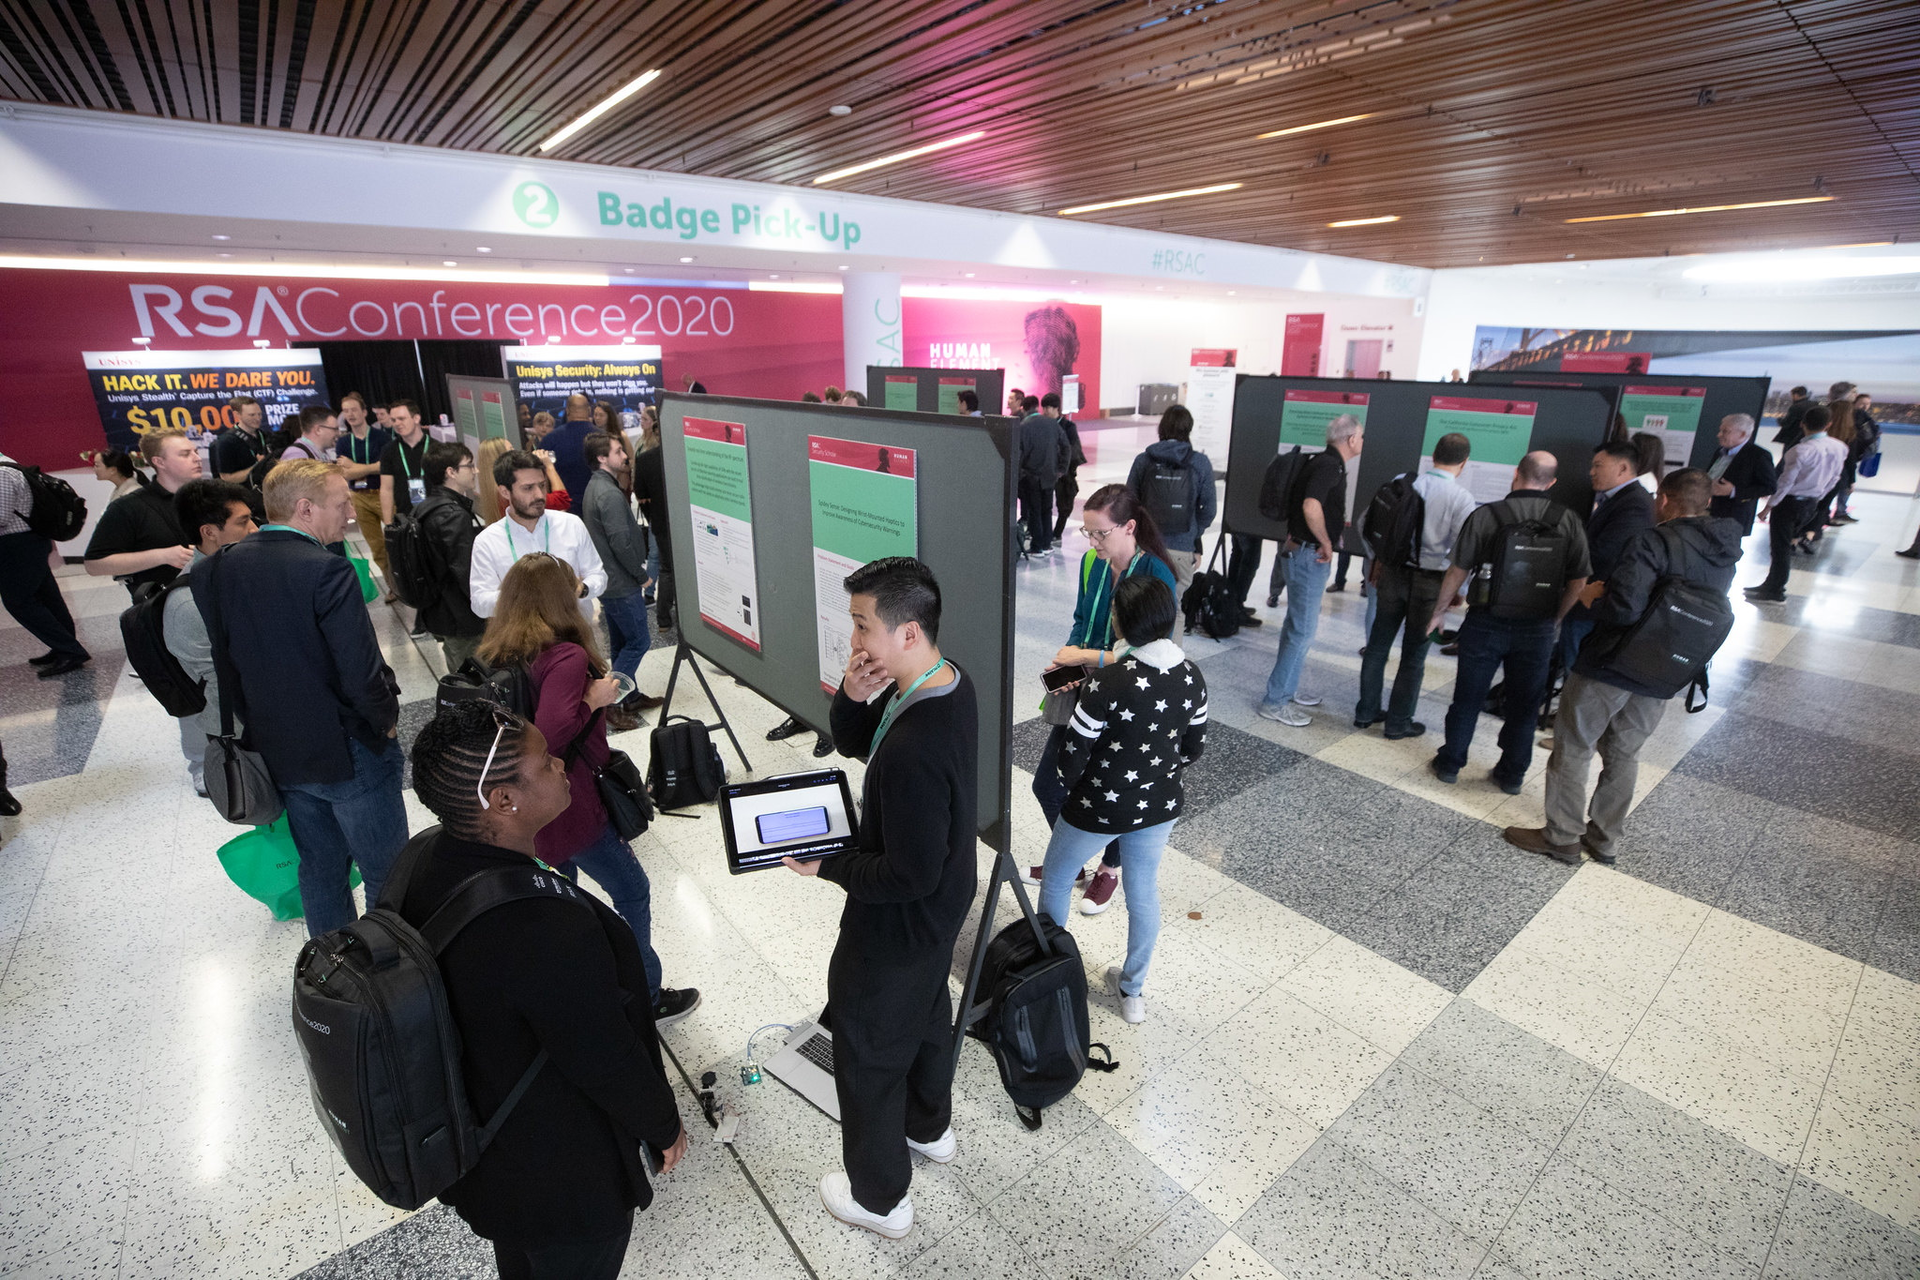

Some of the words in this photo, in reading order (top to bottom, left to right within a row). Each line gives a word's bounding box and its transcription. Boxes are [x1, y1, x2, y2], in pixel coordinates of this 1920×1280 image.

[522, 183, 551, 225] 2
[597, 191, 721, 240] Badge
[731, 203, 862, 250] Pick-Up
[1151, 248, 1206, 275] #RSAC
[929, 343, 991, 358] HUMAN
[515, 365, 554, 379] Unisys
[554, 364, 602, 378] Security:
[603, 363, 641, 377] Always
[641, 363, 656, 374] On
[929, 358, 1001, 370] ELEMENT
[102, 374, 161, 391] HACK
[164, 373, 188, 390] IT.
[190, 373, 220, 389] WE
[225, 371, 272, 388] DARE
[276, 370, 316, 386] YOU.
[519, 381, 543, 389] Attacks
[556, 380, 580, 390] happen
[580, 380, 591, 388] but
[591, 380, 605, 389] they
[107, 394, 140, 403] Unisys
[180, 391, 216, 401] Capture
[216, 390, 232, 399] the
[253, 389, 275, 399] (CTF)
[276, 388, 318, 397] Challenge.
[519, 390, 536, 398] Even
[536, 389, 542, 397] if
[542, 389, 571, 397] someone
[594, 387, 618, 396] nothing
[618, 387, 624, 395] is
[624, 387, 645, 396] getting
[264, 403, 300, 415] PRIZE
[126, 405, 240, 435] $10,00
